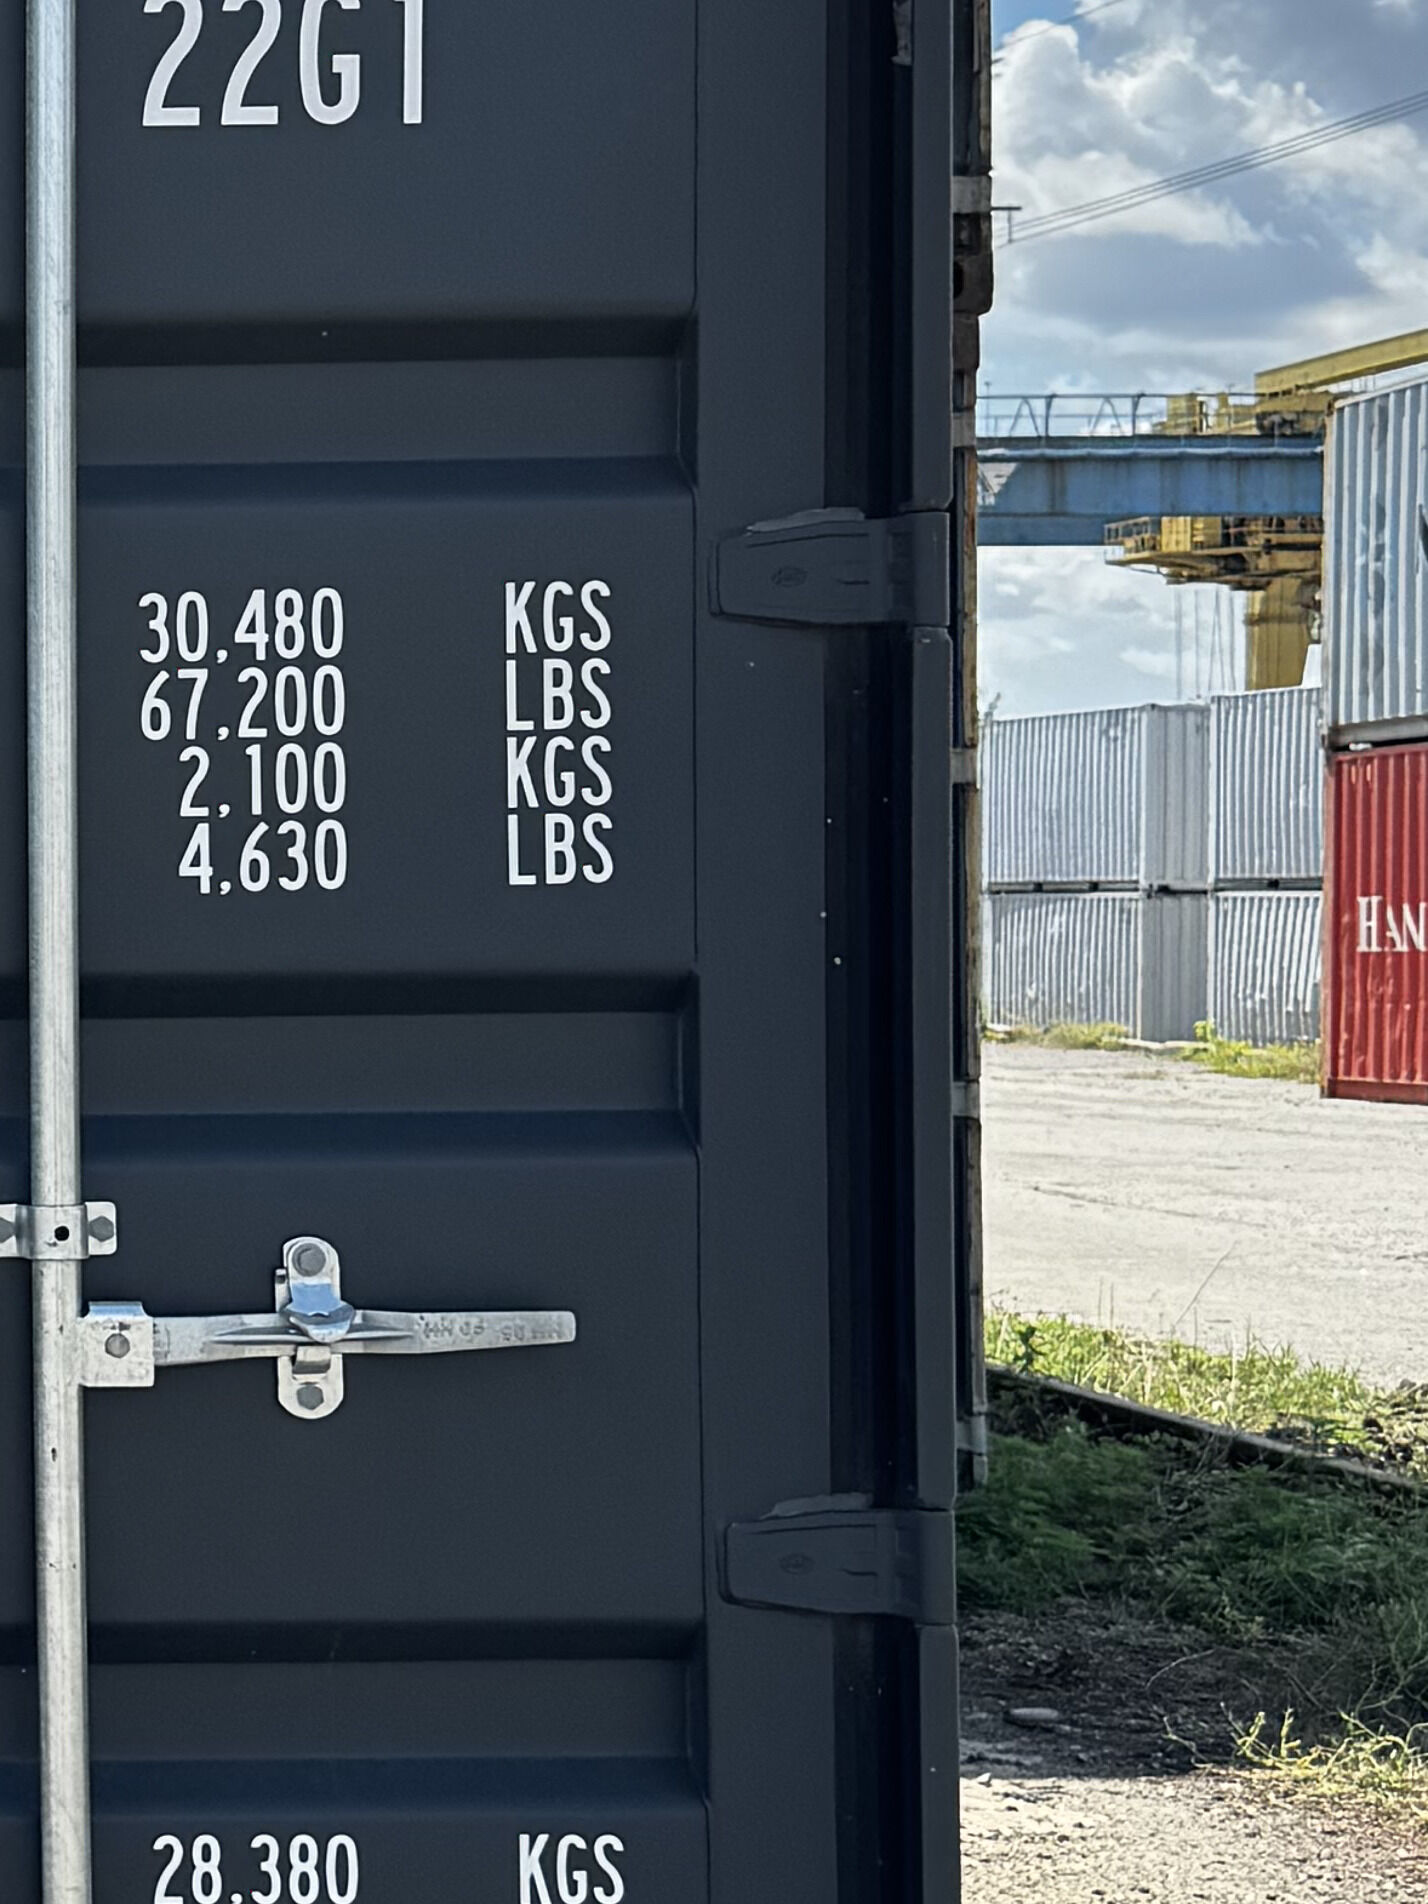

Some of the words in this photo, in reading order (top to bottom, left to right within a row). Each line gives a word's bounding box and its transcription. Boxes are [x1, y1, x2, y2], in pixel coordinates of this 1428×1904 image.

[139, 588, 343, 663] 30,480
[506, 581, 610, 653] KGS
[142, 665, 344, 740] 67,200
[507, 658, 610, 730] LBS
[180, 742, 345, 817] 2,100
[507, 736, 612, 808] KGS
[179, 820, 346, 894] 4,630
[508, 813, 613, 885] LBS
